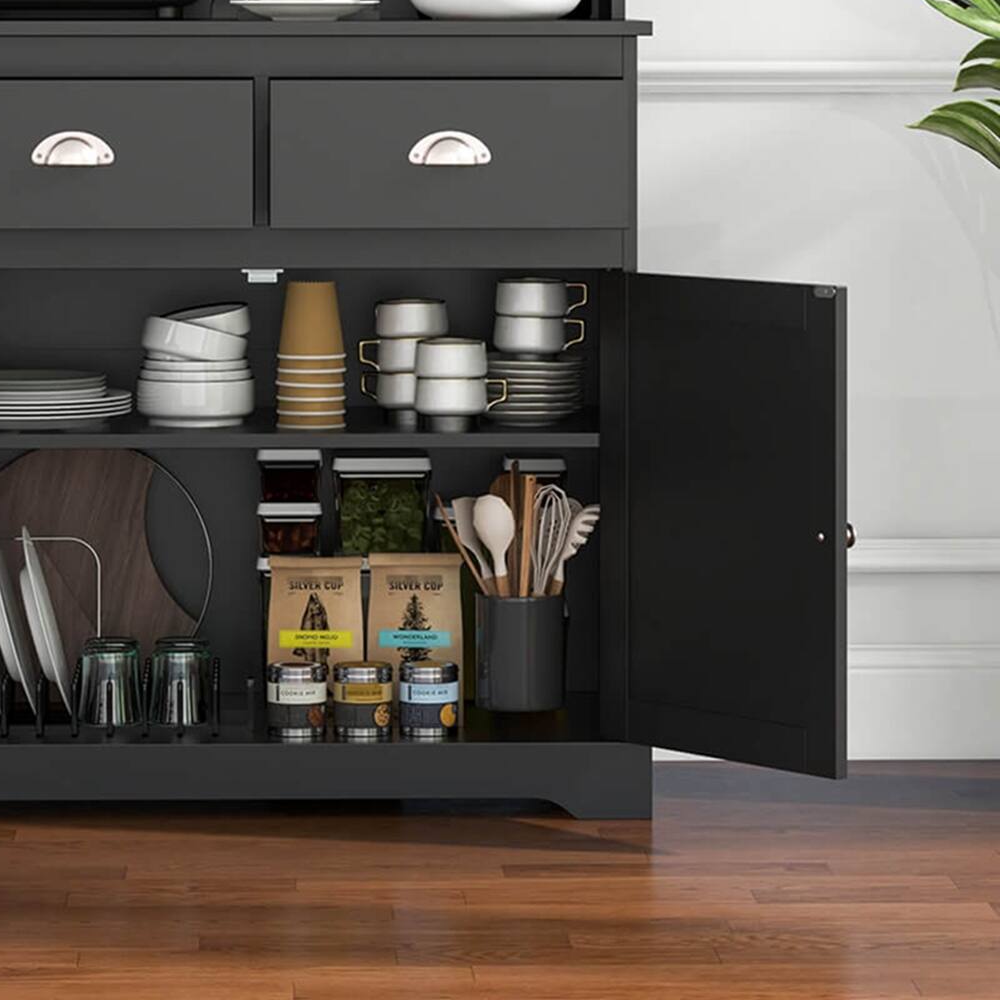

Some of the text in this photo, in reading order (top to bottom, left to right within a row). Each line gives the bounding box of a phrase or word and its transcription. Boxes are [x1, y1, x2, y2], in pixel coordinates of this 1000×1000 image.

[289, 581, 344, 590] SILVER CUP
[389, 581, 444, 590] SILVER CUP
